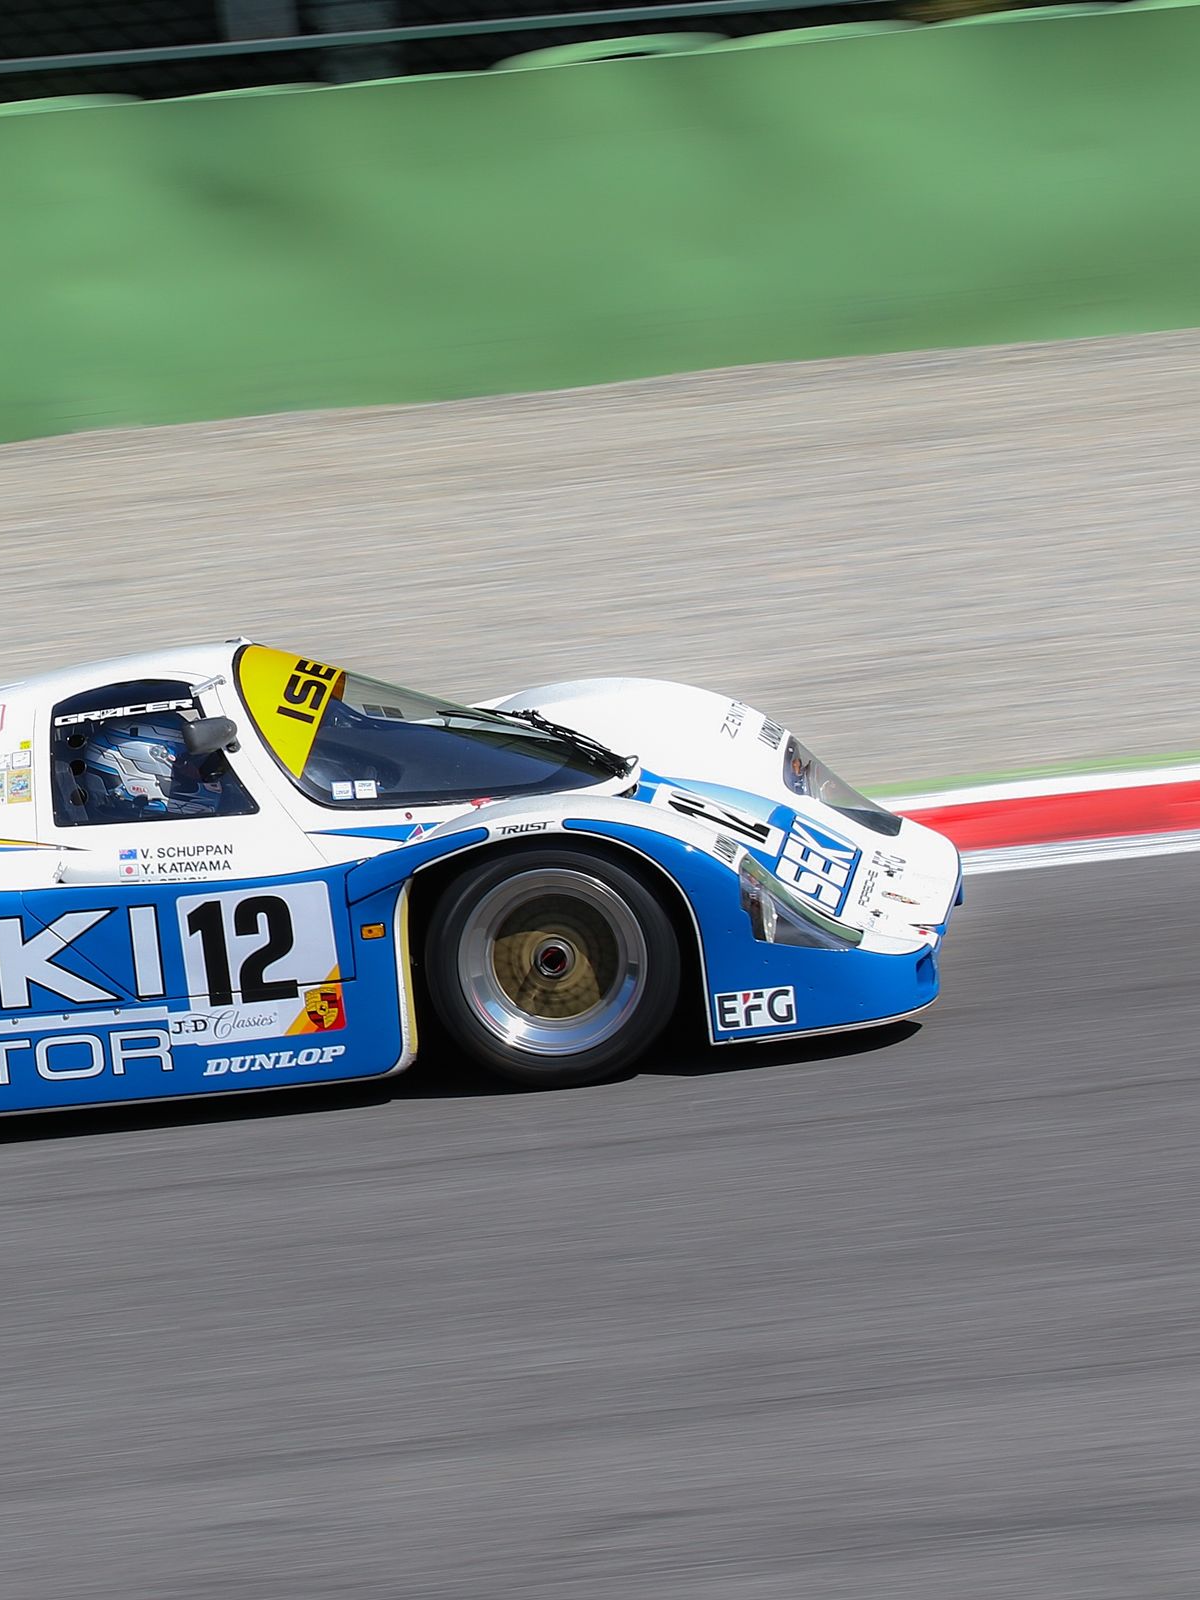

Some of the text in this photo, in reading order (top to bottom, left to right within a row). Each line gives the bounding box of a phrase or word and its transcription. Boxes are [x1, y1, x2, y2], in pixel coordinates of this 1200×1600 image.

[496, 820, 555, 835] TRUST
[140, 844, 233, 859] V. SCHUPPAN
[141, 860, 232, 875] Y. KATAYAMA
[857, 869, 879, 907] PORSCHE
[187, 895, 299, 1006] 12
[717, 989, 794, 1028] EFG
[203, 1045, 346, 1076] DUNLOP
